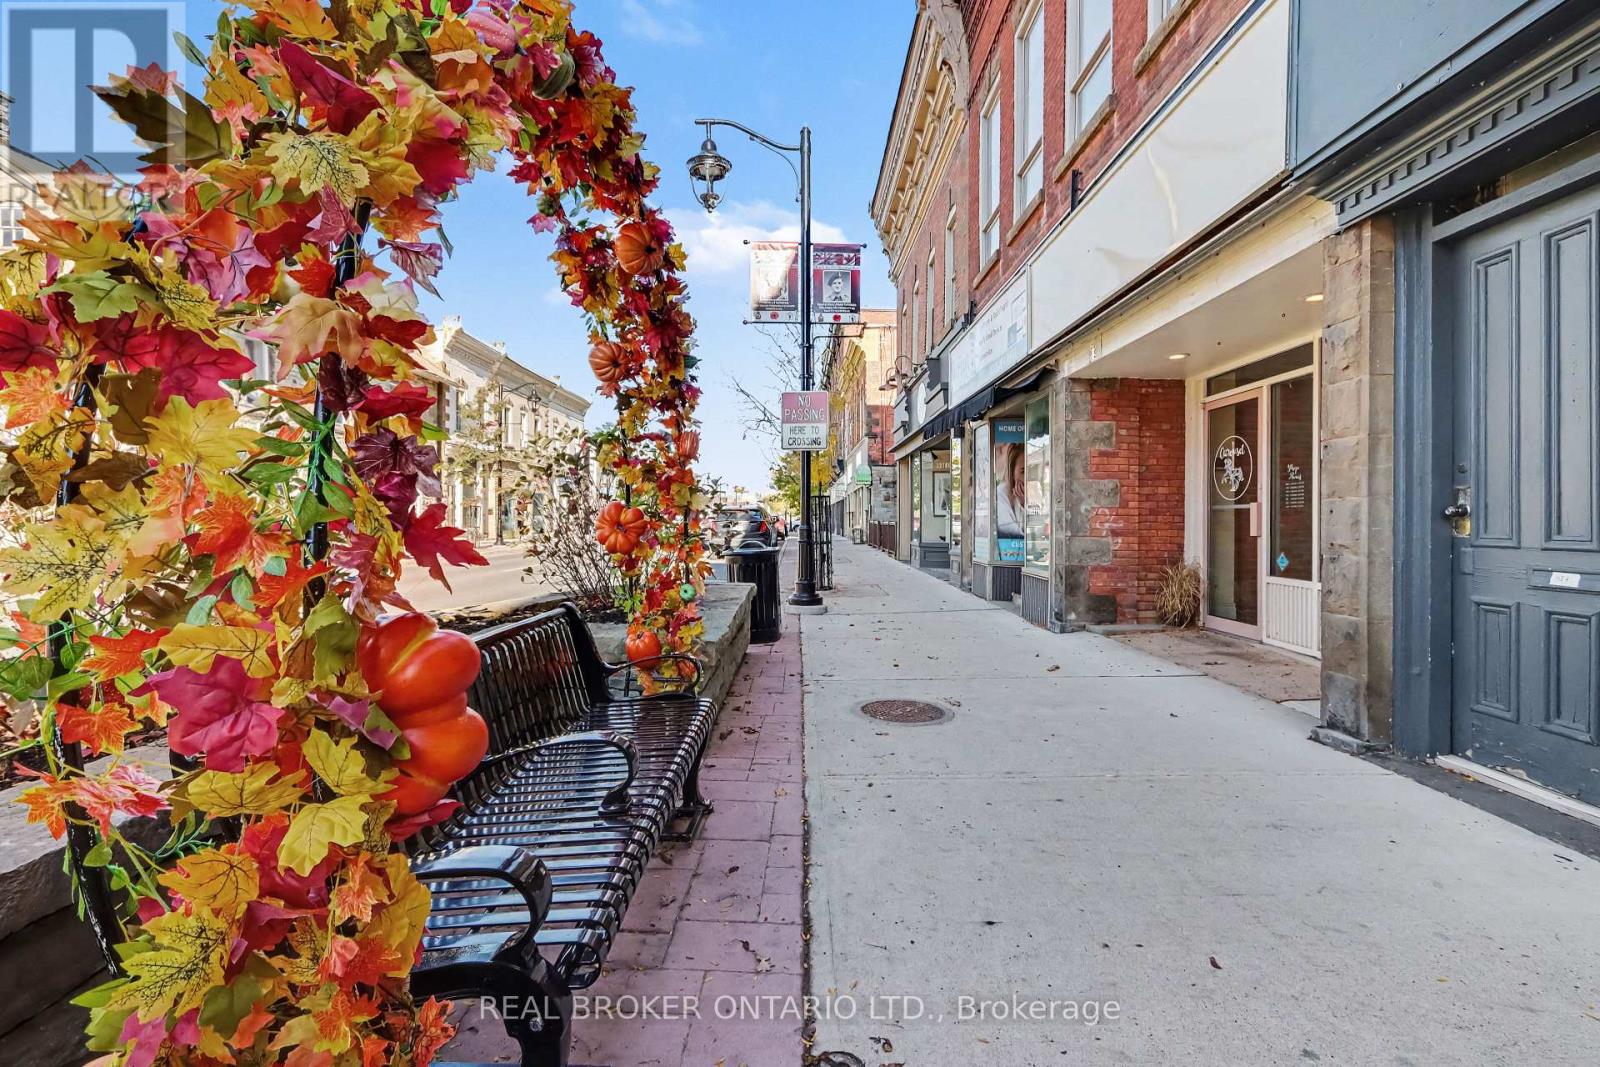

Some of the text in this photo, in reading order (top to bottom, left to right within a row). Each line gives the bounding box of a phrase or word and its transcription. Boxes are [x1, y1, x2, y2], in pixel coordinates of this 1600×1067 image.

[798, 395, 812, 408] NO
[784, 408, 825, 421] PASSING
[789, 425, 820, 435] HERE TO
[787, 437, 822, 447] CROSSING
